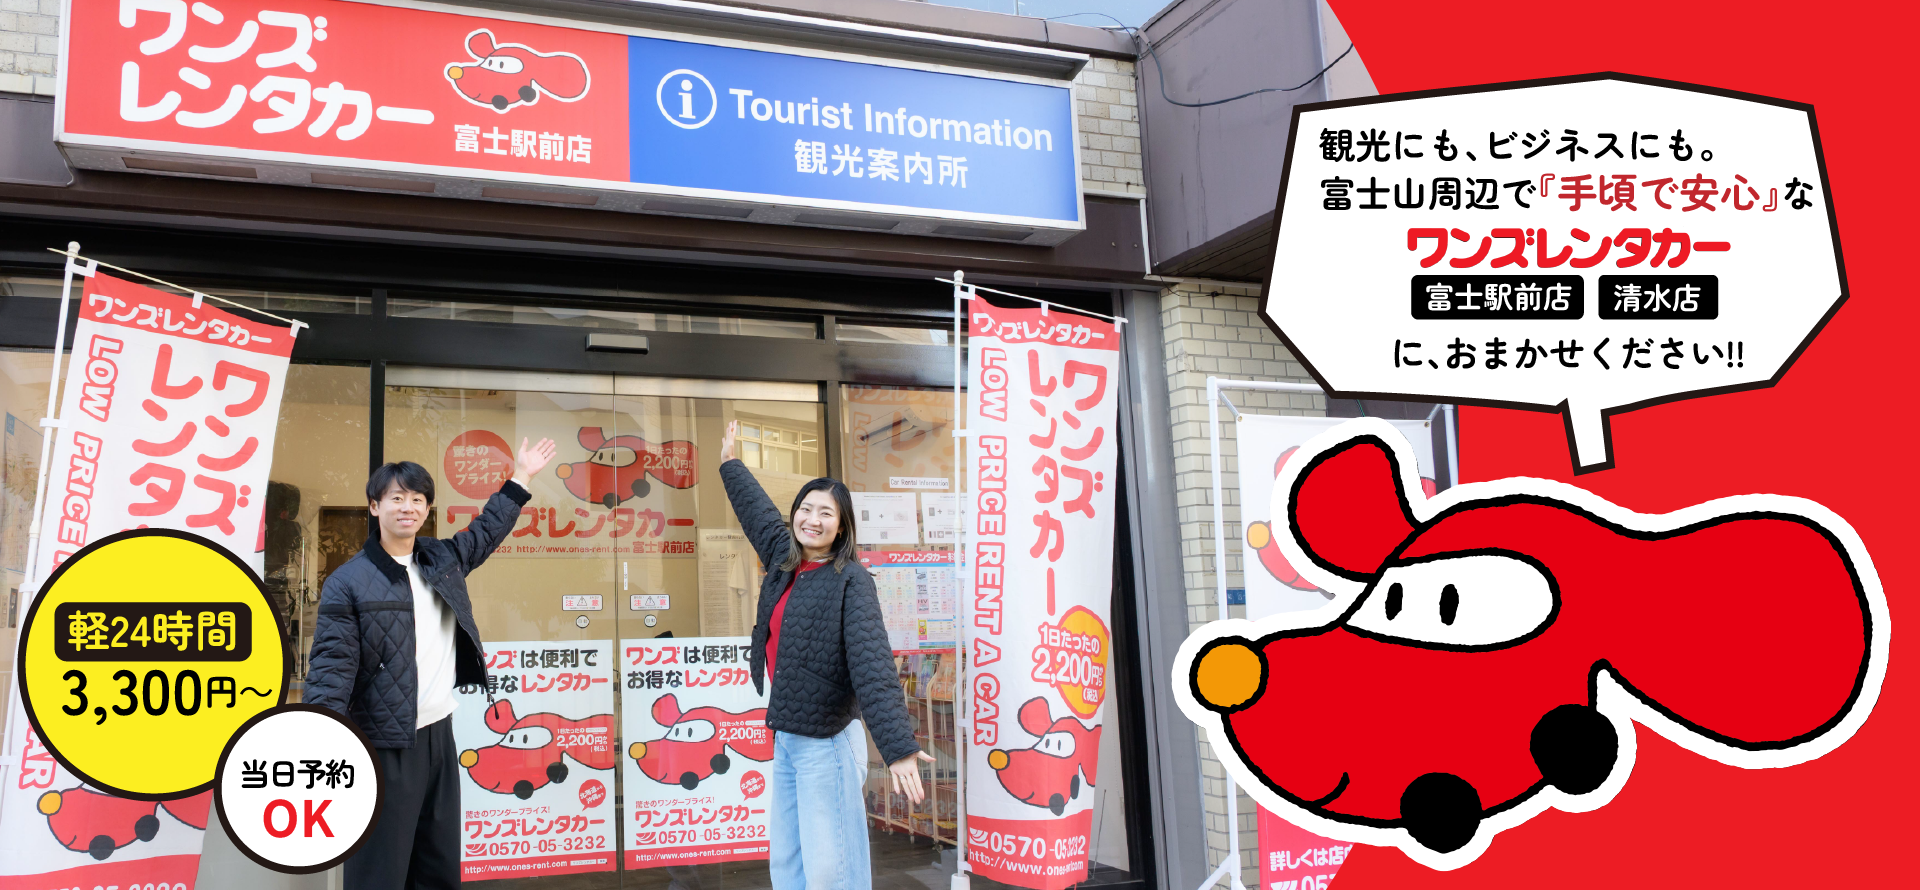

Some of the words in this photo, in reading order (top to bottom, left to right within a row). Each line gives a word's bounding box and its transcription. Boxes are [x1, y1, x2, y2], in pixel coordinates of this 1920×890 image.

[119, 0, 328, 72] ワンズ
[120, 61, 435, 140] レンタカー
[729, 88, 855, 131] Tourist
[863, 103, 1053, 152] Information
[454, 123, 592, 164] 富士駅前店
[794, 138, 969, 189] 観光案内所
[89, 293, 272, 345] ワンズレンタカー
[972, 312, 1105, 345] ワンズレンタカー
[79, 333, 124, 422] LOW
[979, 346, 1009, 422] LOW
[185, 359, 270, 536] ワンズ
[646, 445, 688, 455] 1日たったの
[1060, 359, 1108, 519] ワンズ
[454, 458, 502, 472] ワンダー
[455, 470, 507, 485] プライス!
[890, 478, 900, 486] Car
[1027, 348, 1065, 617] レンタカー
[57, 430, 103, 547] PRICE
[977, 435, 1008, 536] PRICE
[446, 505, 695, 539] ワズレンタカー
[516, 544, 631, 554] http://www.ones-rent.com
[632, 541, 695, 554] 富士駅前店
[974, 541, 1005, 635] RENT
[974, 637, 1001, 668] A
[1040, 624, 1100, 654] 1日たったの
[973, 672, 1000, 746] CAR
[464, 815, 605, 839] ワンズレンタカー
[635, 805, 765, 828] ワンズレンタカー
[658, 825, 766, 844] 0570-05-3232
[489, 835, 606, 856] 0570-05-3232
[636, 849, 731, 862] http://www.ones-rent.com
[464, 860, 568, 874] http://www.ones-rent.com
